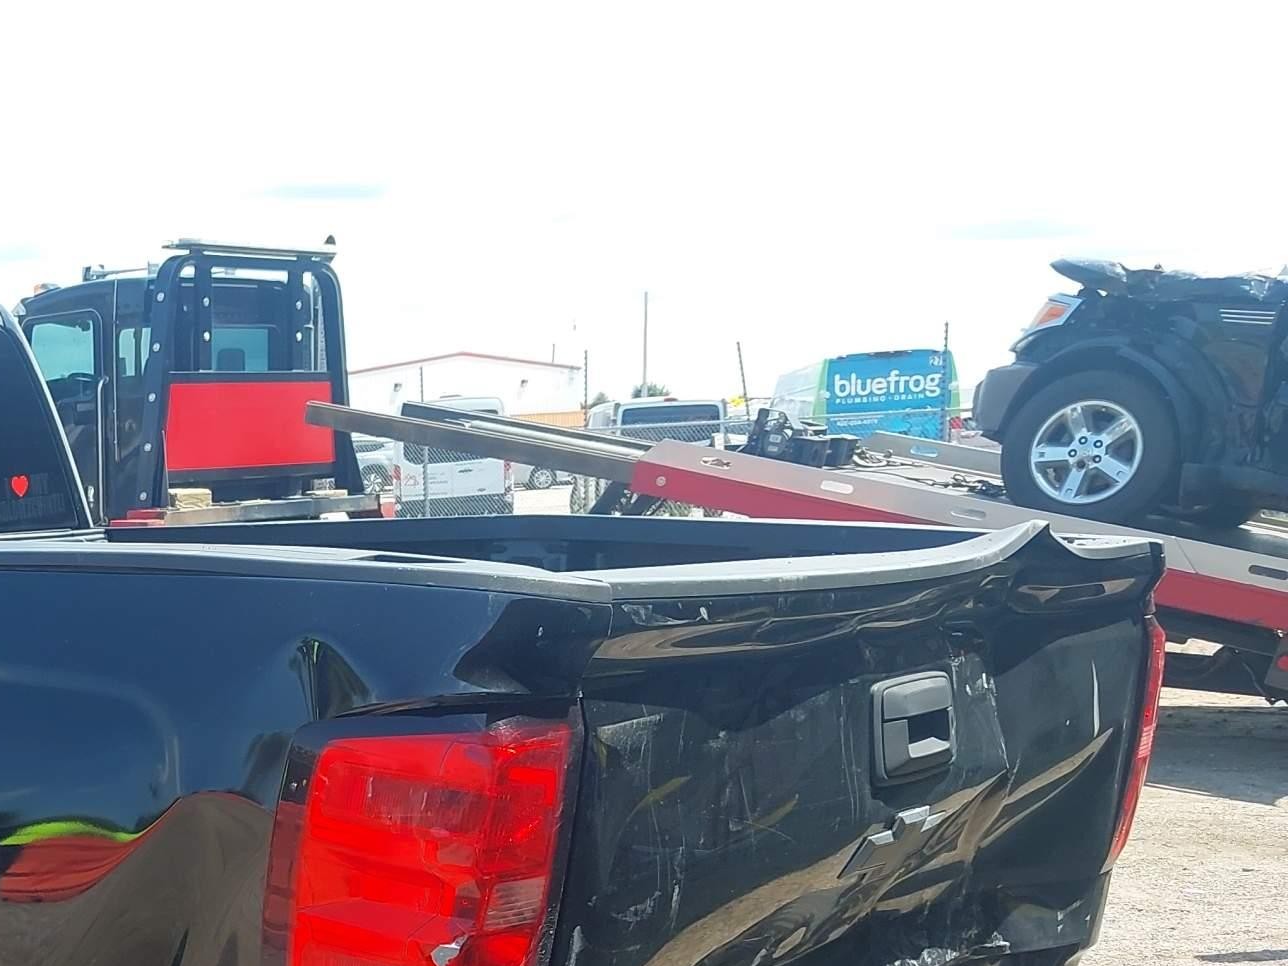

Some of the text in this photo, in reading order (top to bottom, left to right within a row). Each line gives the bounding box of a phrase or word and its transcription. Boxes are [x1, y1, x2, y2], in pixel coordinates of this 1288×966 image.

[834, 369, 943, 398] bluefrog
[835, 393, 925, 405] PLUMBING DRAIN
